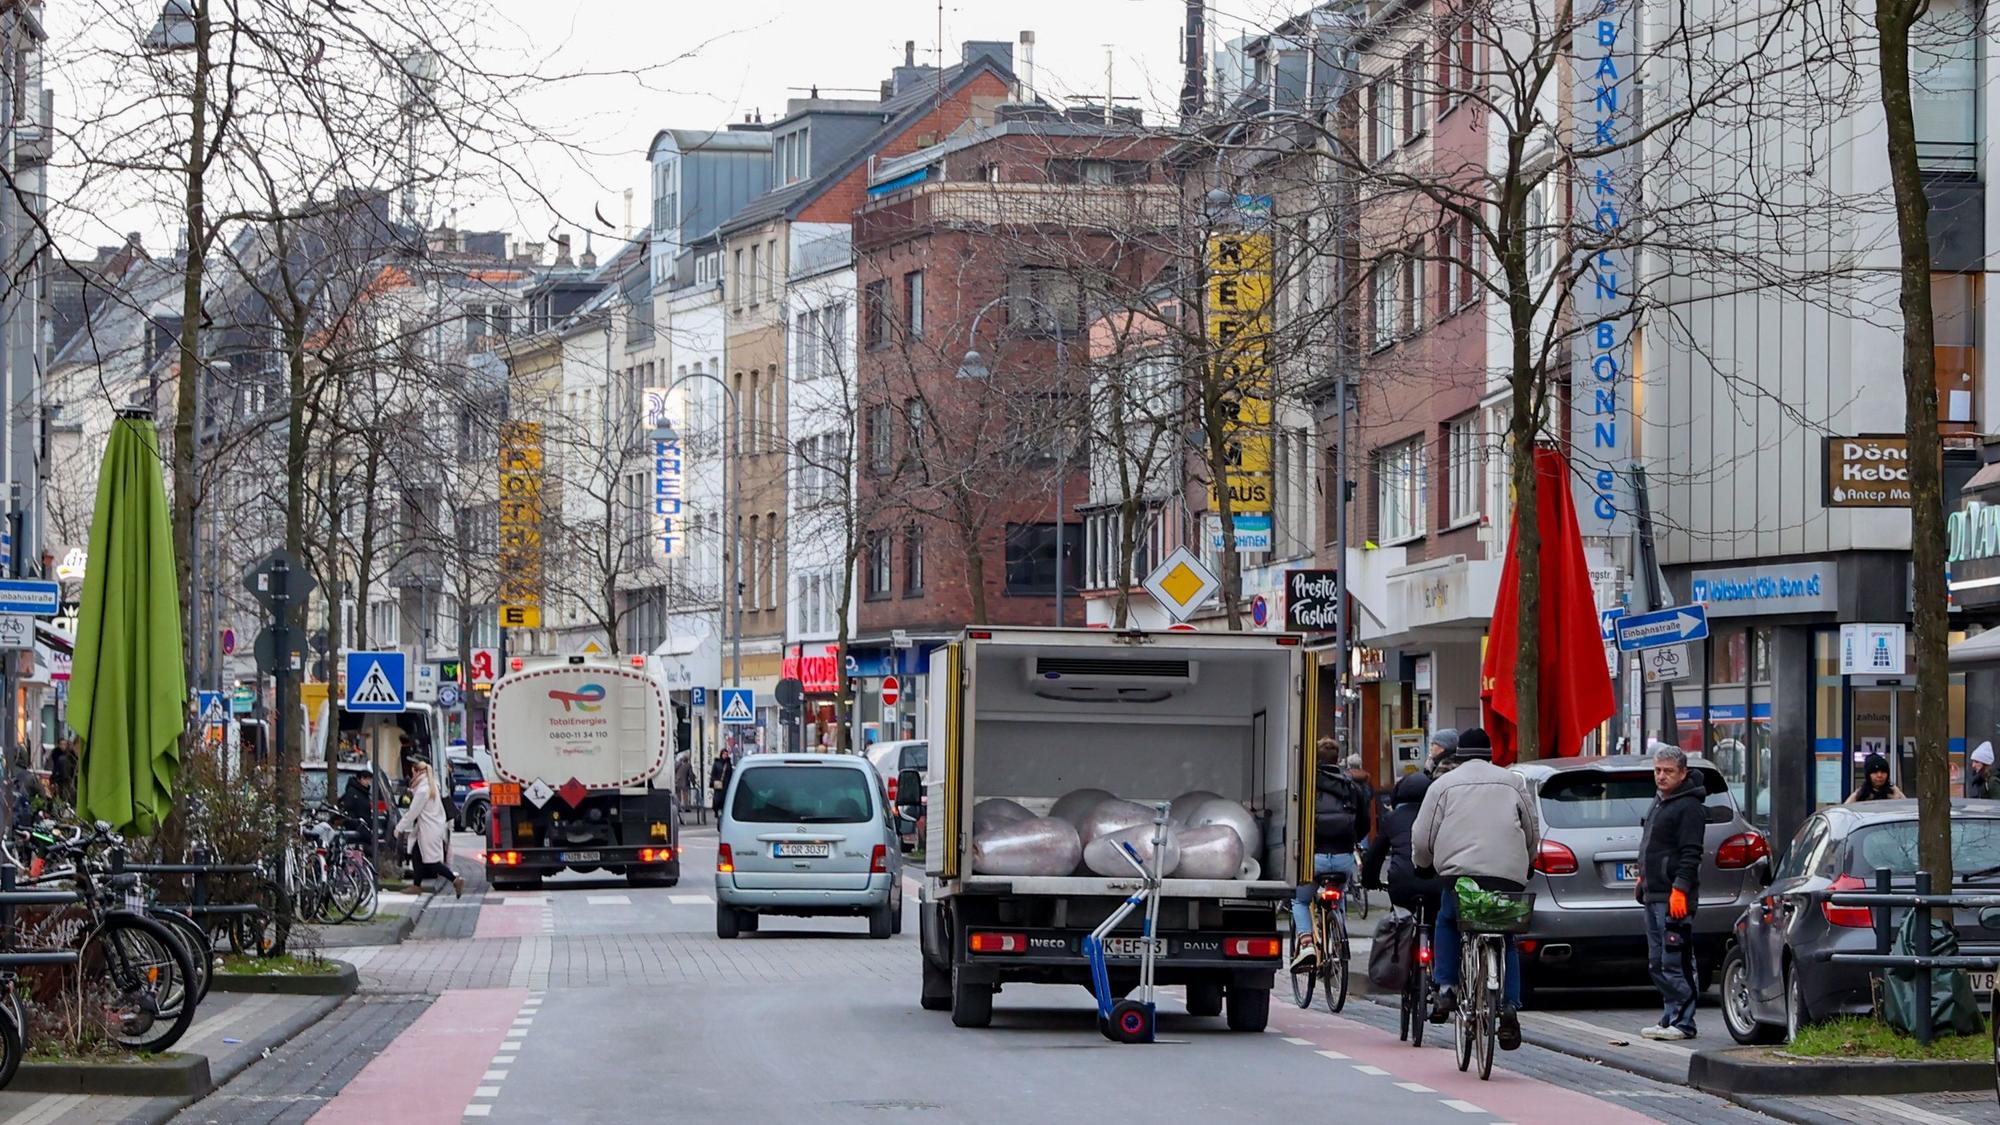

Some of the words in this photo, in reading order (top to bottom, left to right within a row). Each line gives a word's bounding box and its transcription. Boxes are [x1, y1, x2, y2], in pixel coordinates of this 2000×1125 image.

[1595, 170, 1617, 299] KÖLN
[1594, 323, 1617, 447] BONN
[1594, 470, 1617, 519] eG
[1847, 489, 1886, 502] Antep
[1890, 489, 1911, 500] Ma
[1589, 570, 1613, 580] ngstr.
[1711, 577, 1755, 601] Volksbank
[1756, 576, 1777, 599] Köln
[1780, 576, 1804, 598] Bonn
[1807, 573, 1820, 595] eG
[0, 592, 53, 602] inbahnstraße
[1623, 622, 1680, 639] Einbahnstraße
[549, 718, 607, 726] TotalEnergies
[550, 731, 581, 739] 0800-11
[805, 845, 826, 855] 3037
[1030, 938, 1066, 948] IVECO
